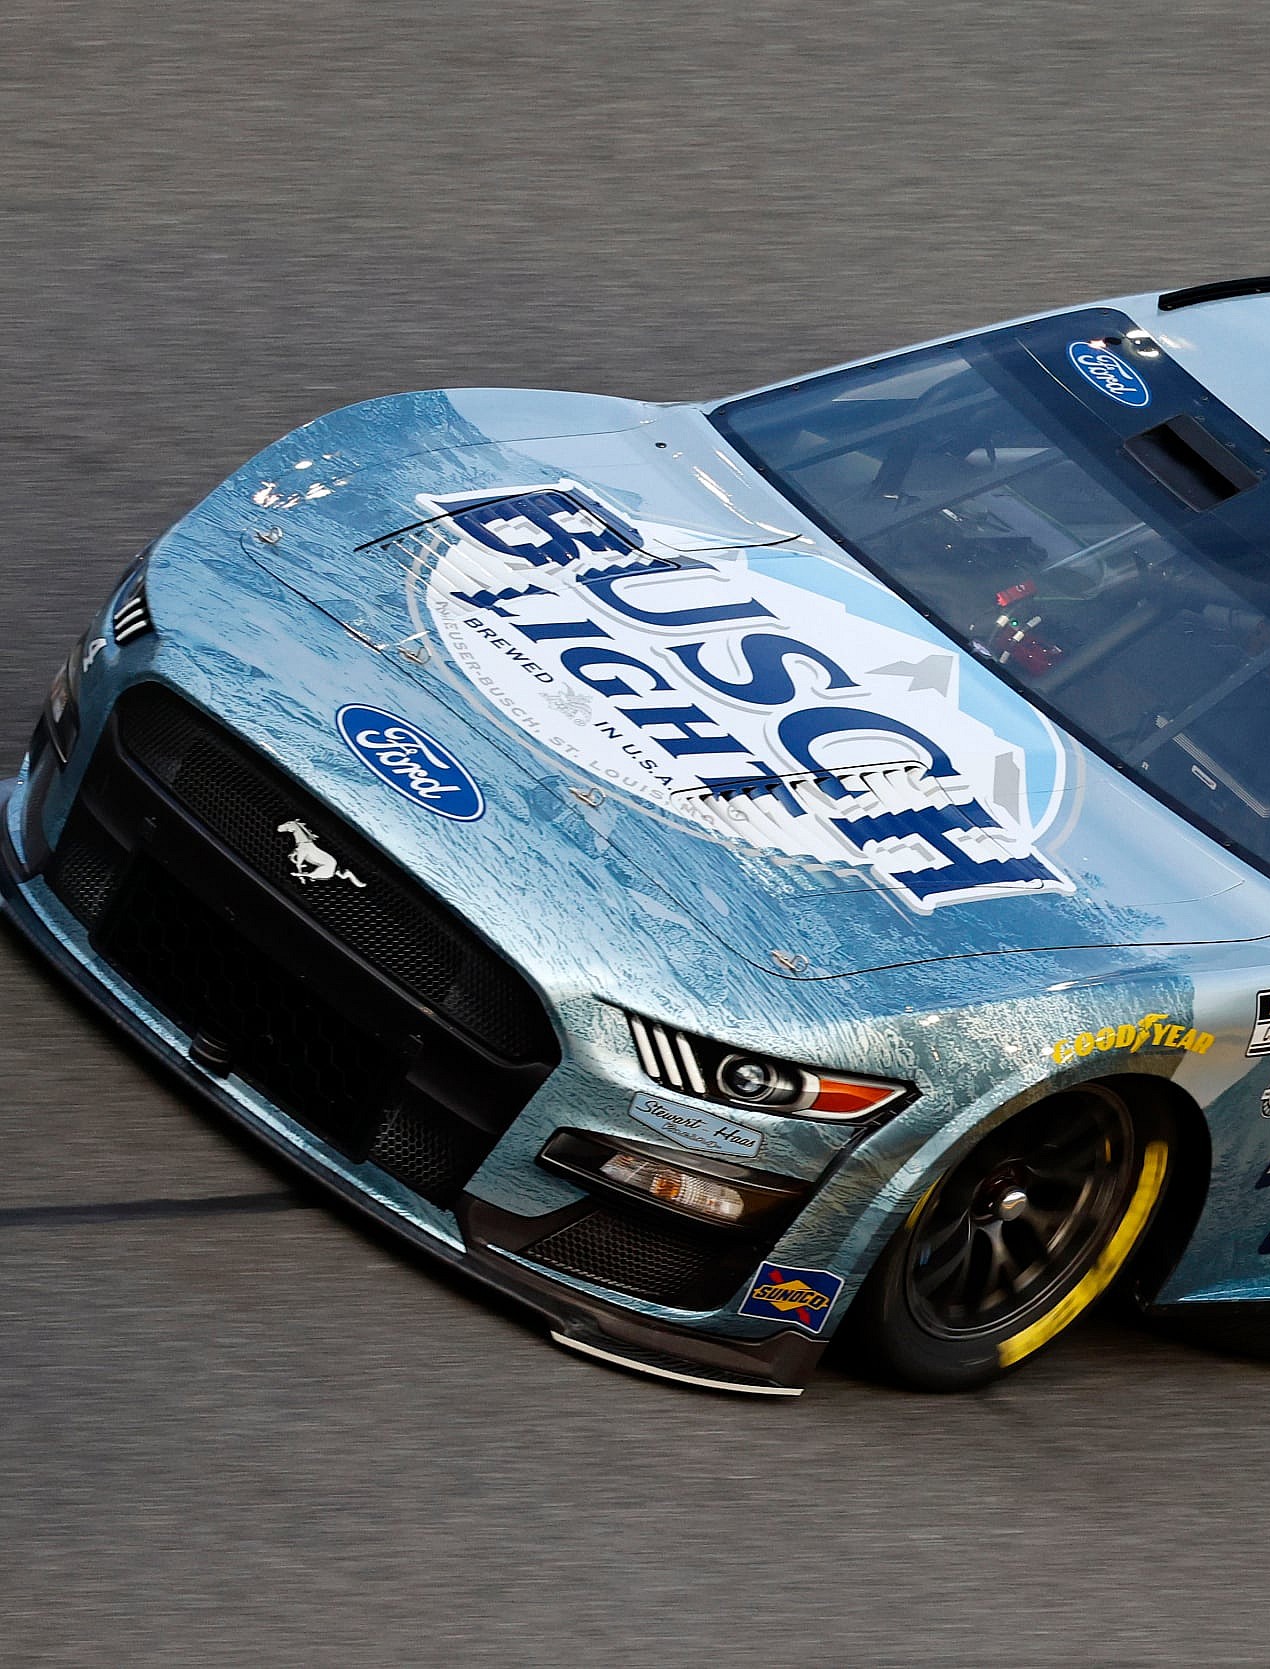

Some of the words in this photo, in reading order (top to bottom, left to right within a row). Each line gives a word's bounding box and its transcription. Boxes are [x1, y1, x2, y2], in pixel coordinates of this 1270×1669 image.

[1078, 355, 1137, 399] Ford
[422, 485, 1074, 907] BUSCH
[449, 584, 802, 818] LIGHT
[463, 617, 555, 684] BREWED
[593, 720, 624, 740] IN
[621, 743, 674, 791] U.S.A.
[355, 728, 460, 800] Ford
[549, 736, 581, 759] ST.
[1052, 1013, 1216, 1065] GOODYEAR
[755, 1286, 825, 1308] SUNOCO
